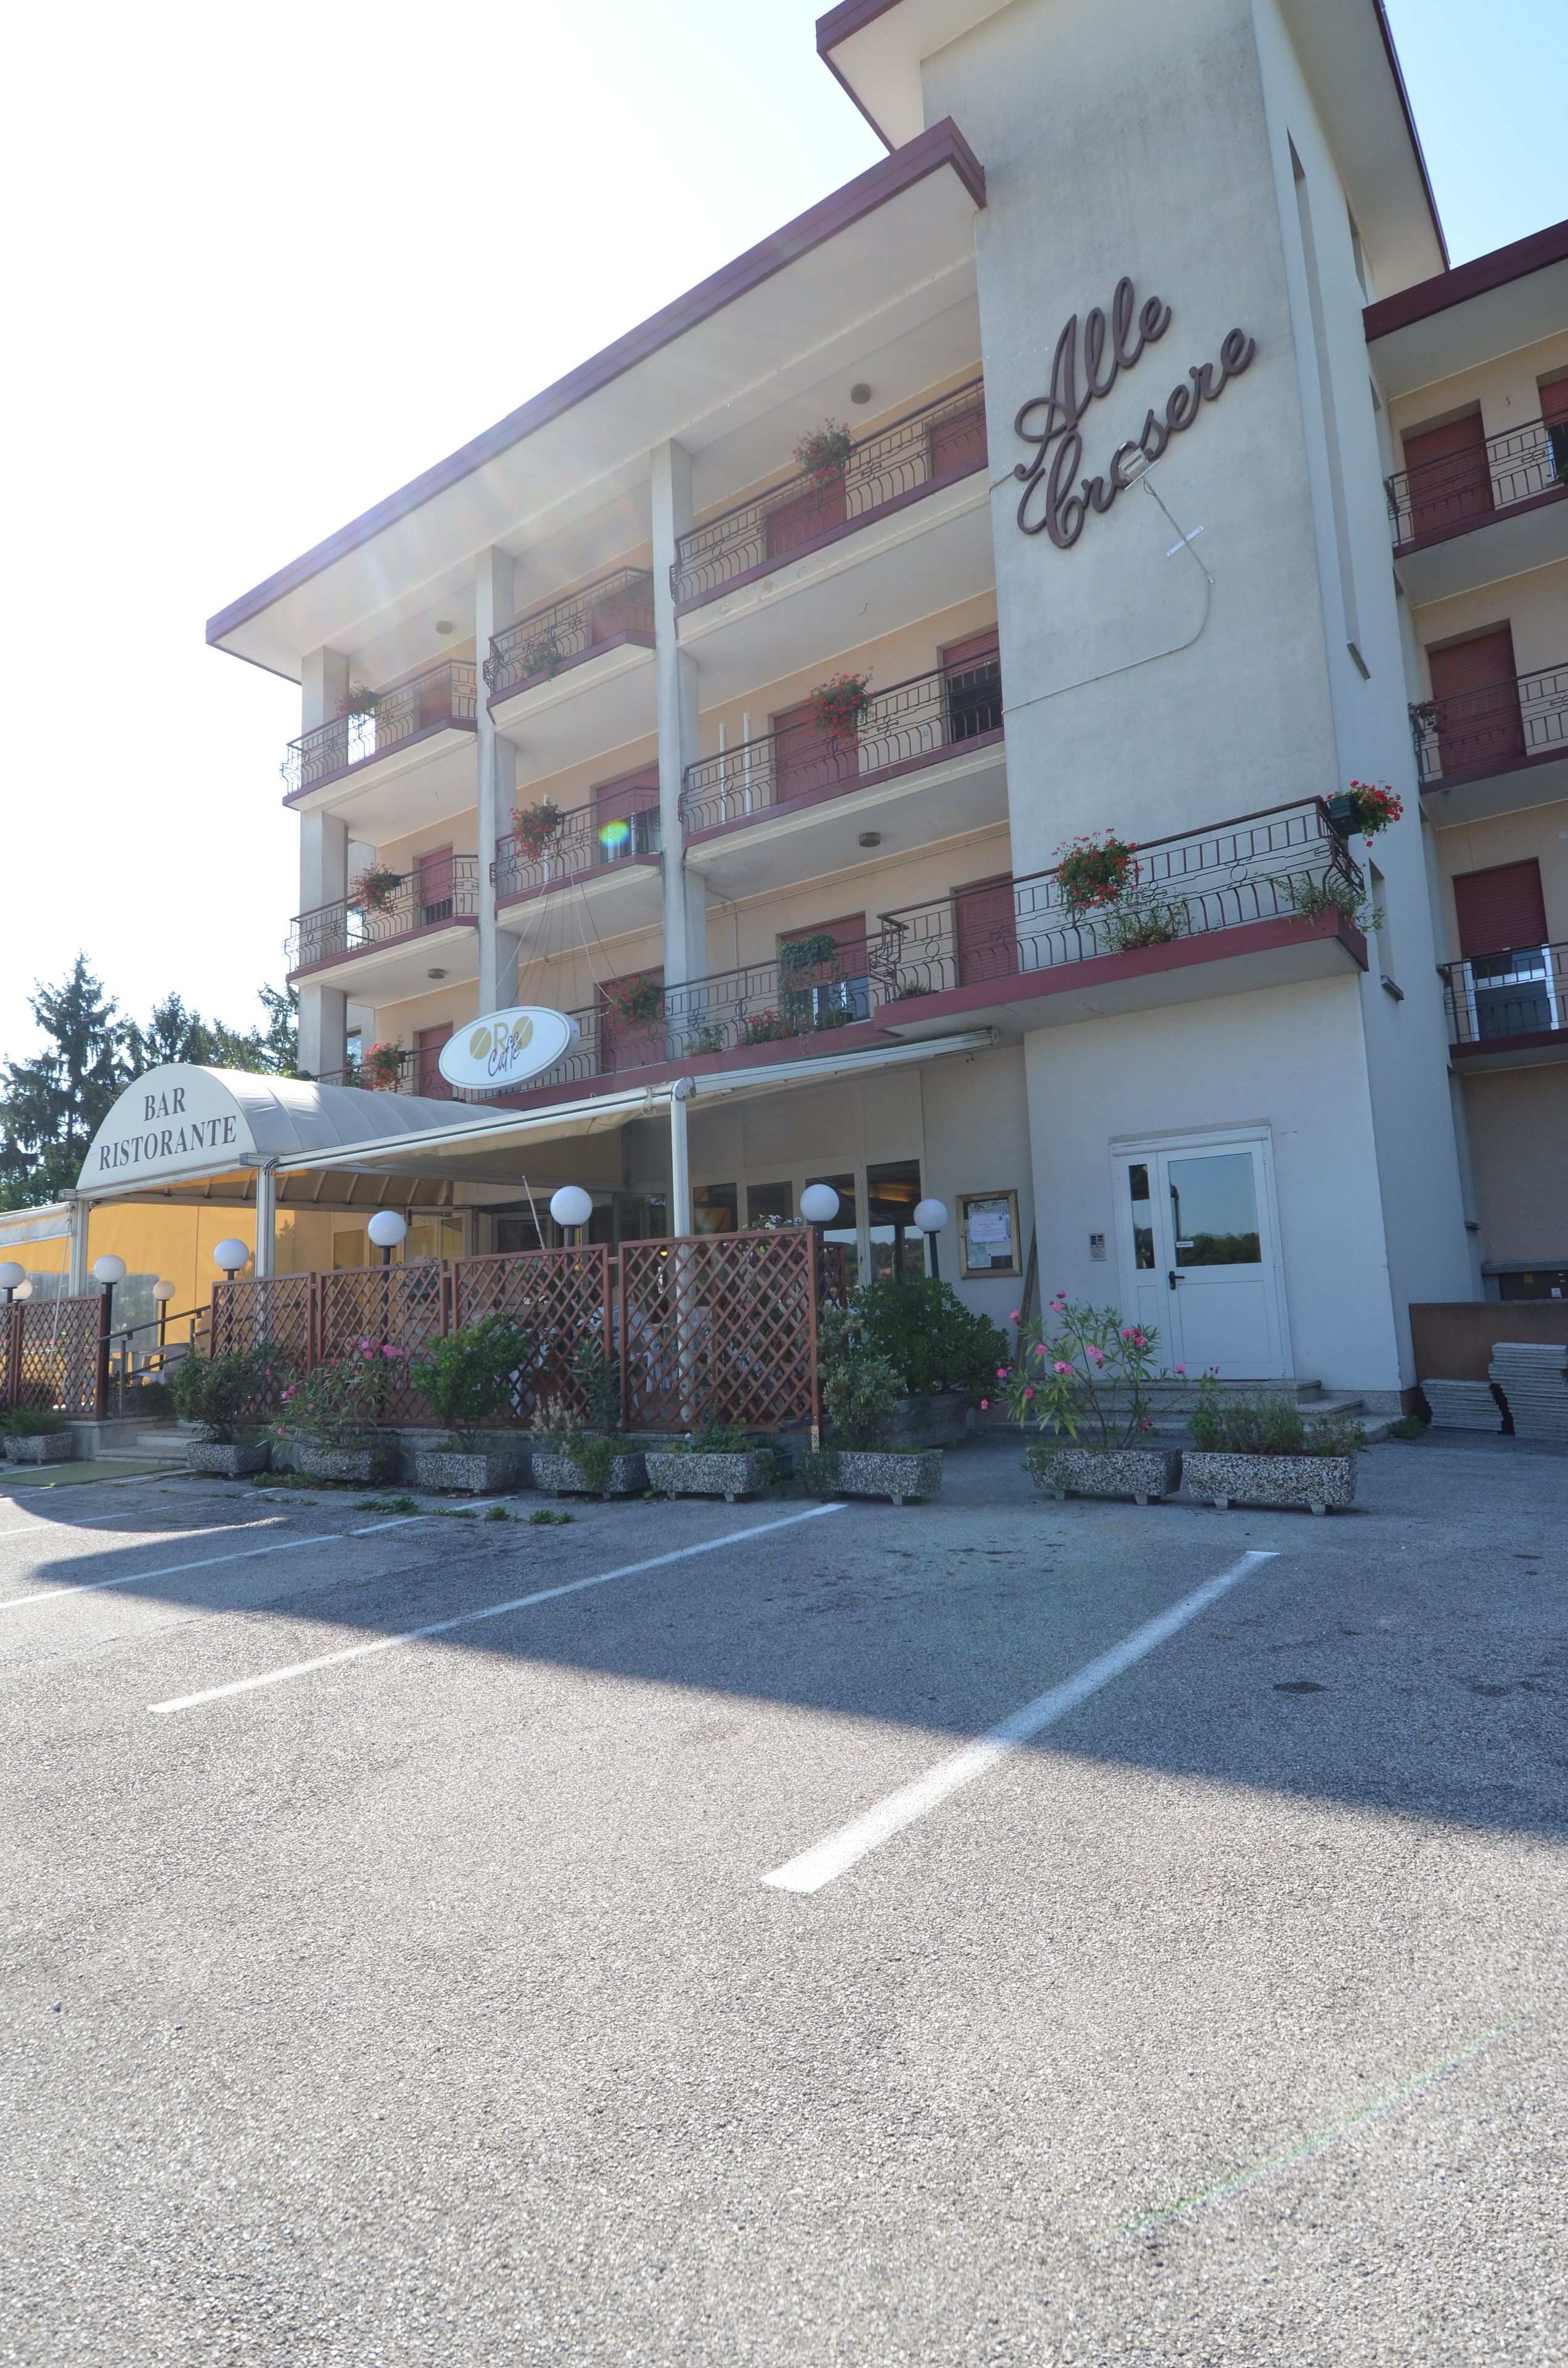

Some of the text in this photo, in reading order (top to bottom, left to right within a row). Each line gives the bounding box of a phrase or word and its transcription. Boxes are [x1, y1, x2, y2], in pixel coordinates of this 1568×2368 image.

[1014, 276, 1172, 481] Alle
[470, 1016, 533, 1060] ORO
[144, 1087, 186, 1122] BAR
[99, 1116, 237, 1170] RISTORANTE
